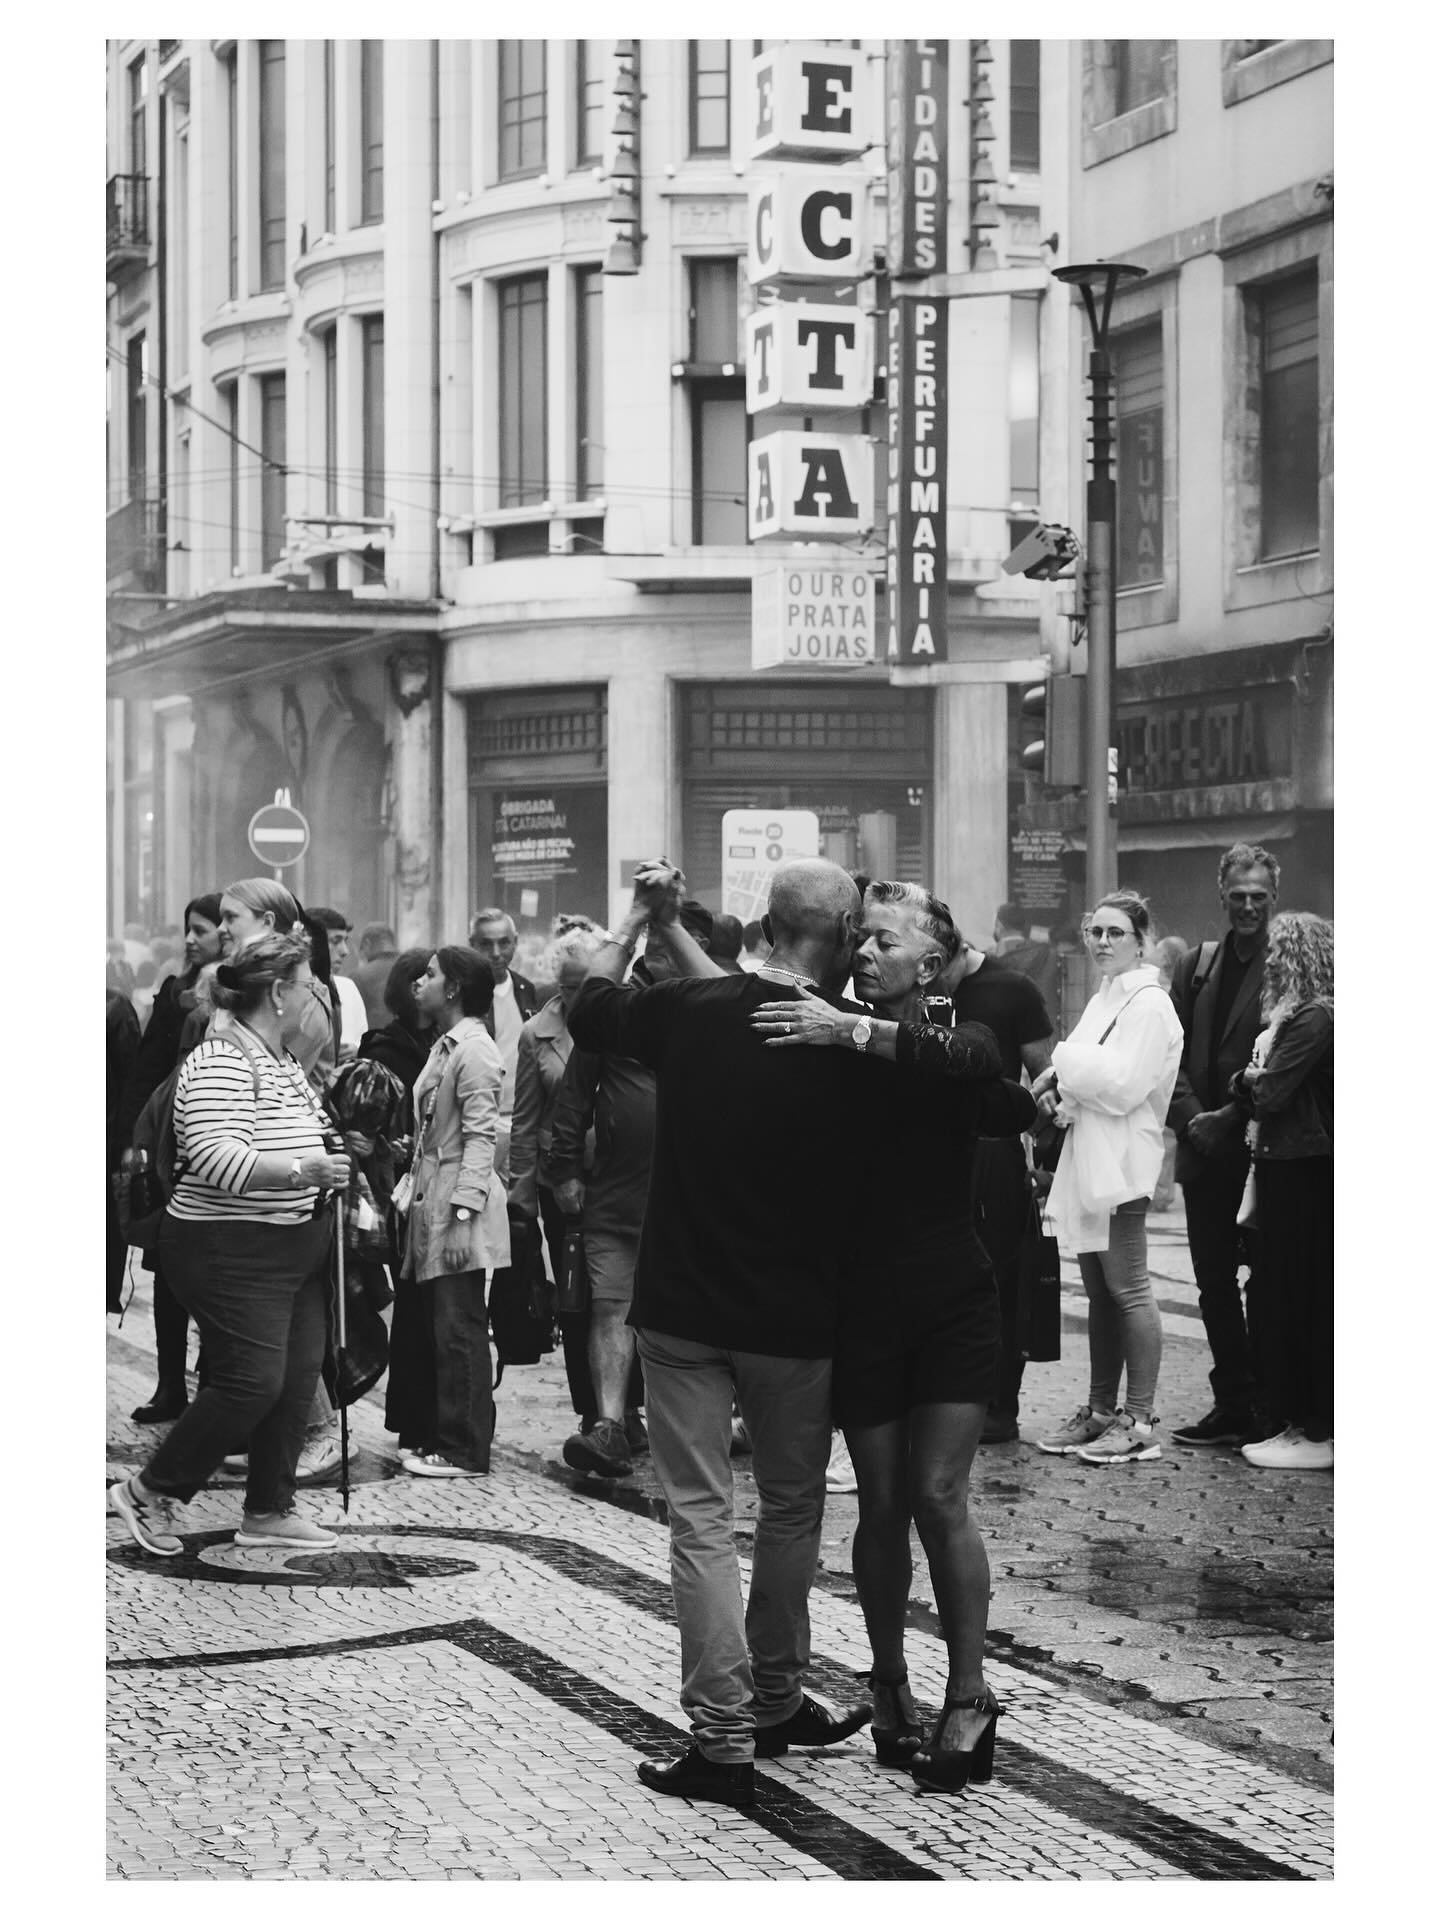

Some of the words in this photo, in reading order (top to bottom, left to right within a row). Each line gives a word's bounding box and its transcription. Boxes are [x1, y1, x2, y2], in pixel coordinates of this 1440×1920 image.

[887, 306, 900, 656] PERFUMARIA
[910, 304, 939, 655] PERFUMARIA
[788, 573, 867, 597] OURO
[788, 603, 867, 628] PRATA
[788, 635, 867, 657] JOIAS
